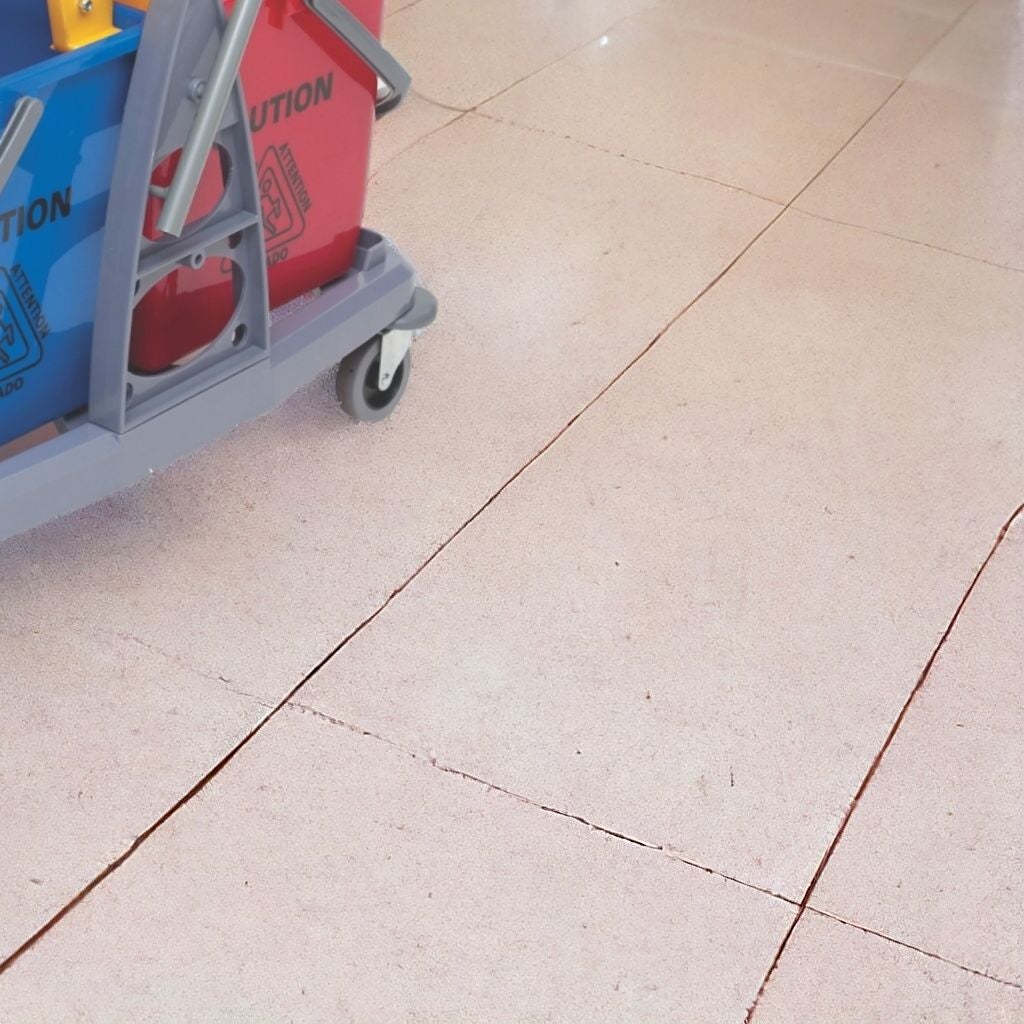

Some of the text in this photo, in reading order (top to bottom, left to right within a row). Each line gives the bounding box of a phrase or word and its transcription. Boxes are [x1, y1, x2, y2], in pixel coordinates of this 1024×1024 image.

[249, 71, 334, 134] UTION
[279, 142, 312, 214] ATTENTION
[10, 263, 51, 339] ATTENTION
